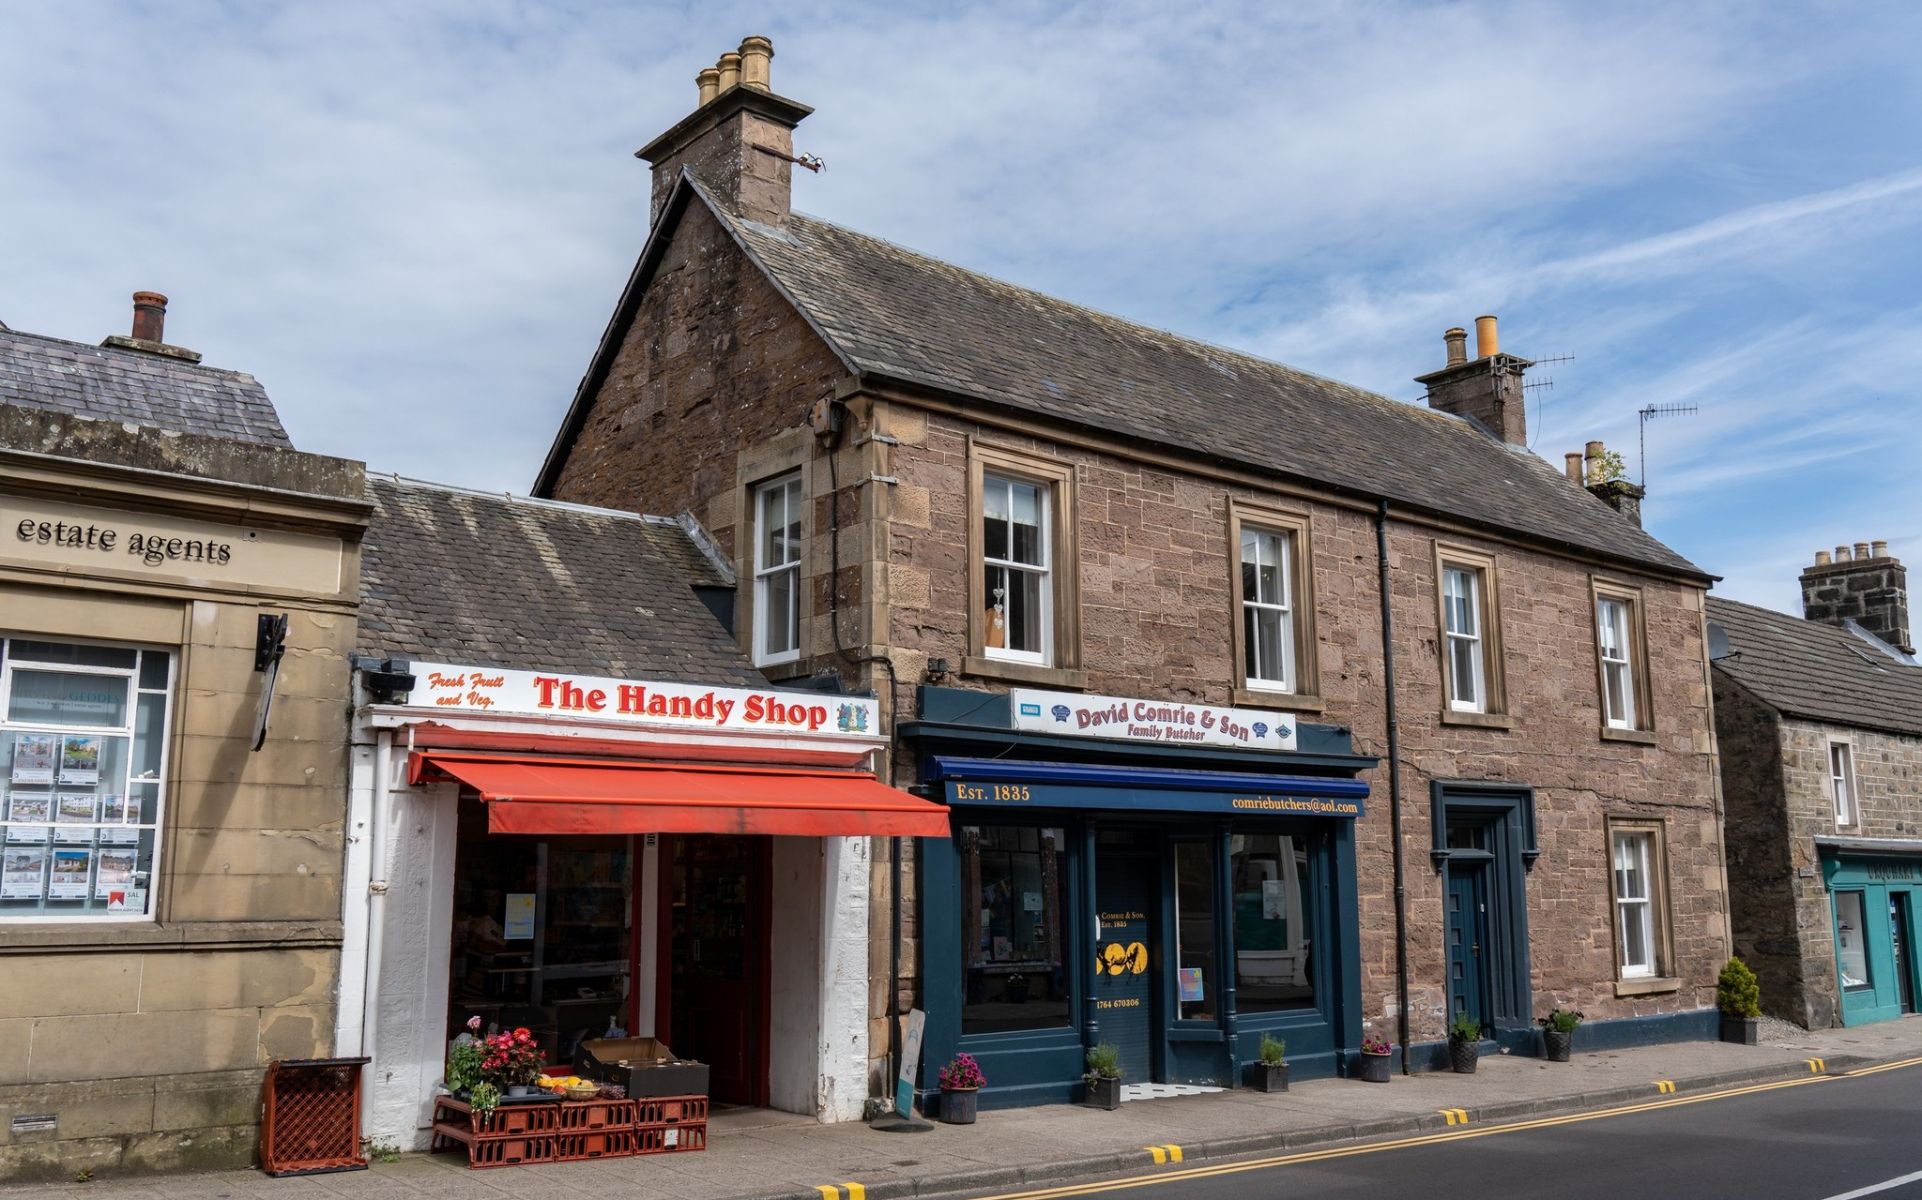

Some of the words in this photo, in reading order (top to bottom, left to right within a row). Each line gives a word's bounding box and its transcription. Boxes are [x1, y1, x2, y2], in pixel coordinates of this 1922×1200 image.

[17, 518, 117, 549] estate
[129, 532, 231, 562] agents
[428, 672, 465, 690] Fresh
[469, 672, 504, 690] Fruit
[436, 692, 462, 706] and
[466, 691, 495, 709] Veg.
[533, 676, 607, 712] The
[616, 684, 735, 726] Handy
[742, 694, 828, 732] Shop
[1075, 702, 1129, 729] David
[1133, 702, 1195, 726] Comrie
[1199, 709, 1216, 729] &
[1219, 715, 1249, 742] Son
[1127, 723, 1162, 740] Family
[1165, 726, 1206, 741] Butcher
[994, 785, 1030, 801] 1835
[1232, 796, 1358, 813] comriebutchers@aol.com
